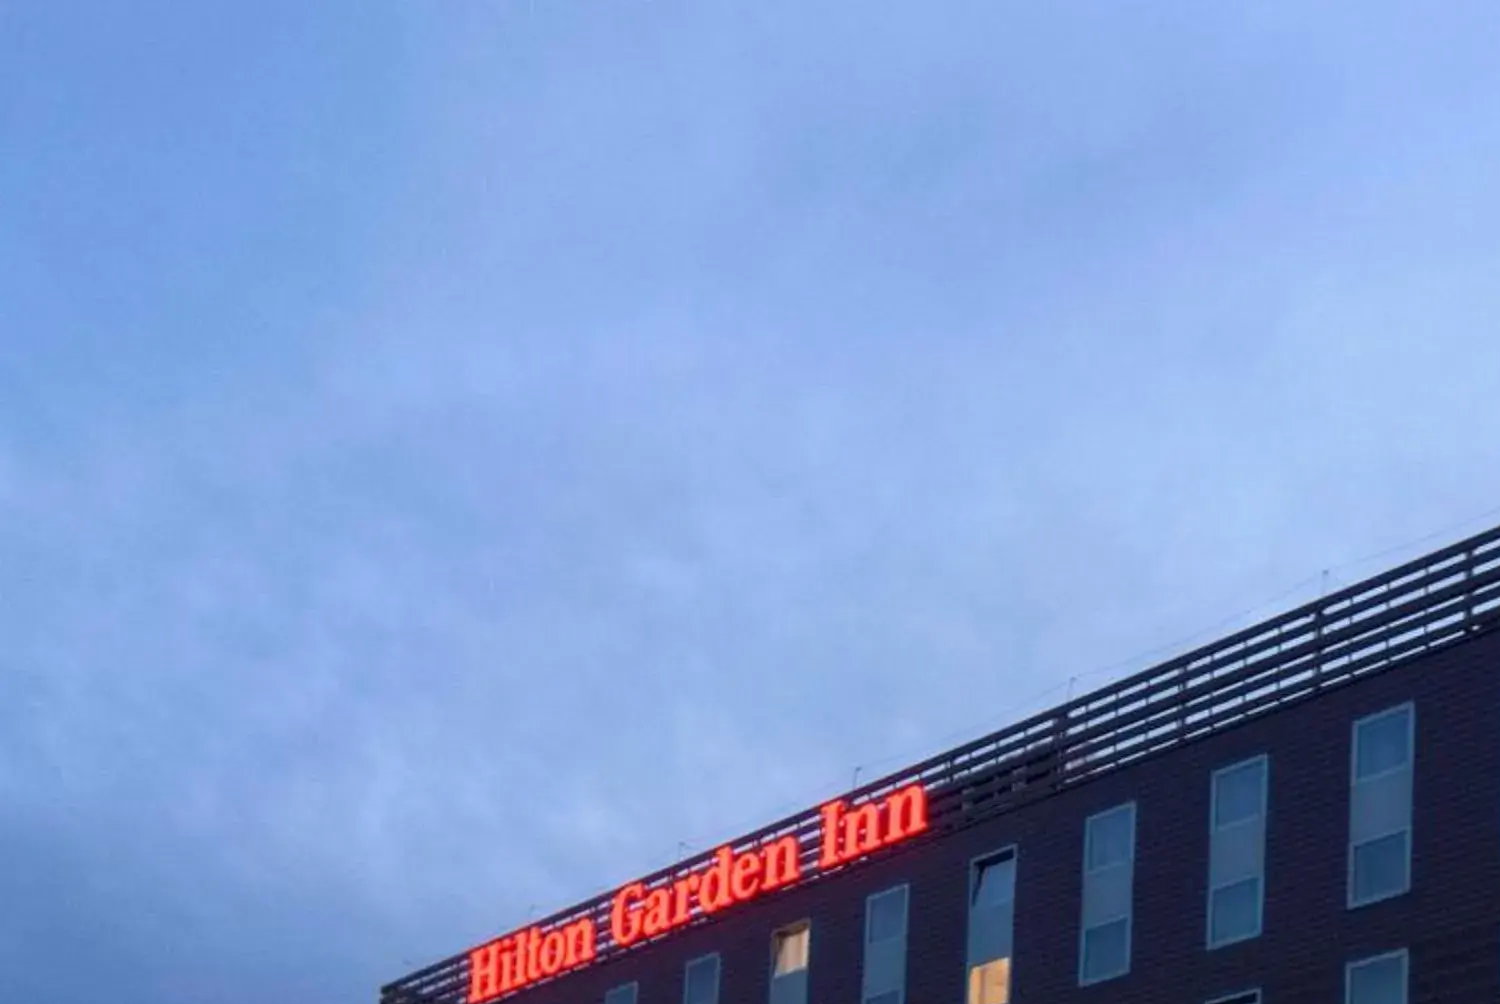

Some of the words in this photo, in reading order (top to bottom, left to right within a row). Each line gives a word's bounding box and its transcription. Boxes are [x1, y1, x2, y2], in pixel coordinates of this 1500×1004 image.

[468, 918, 594, 1004] Hilton
[610, 835, 799, 946] Garden
[819, 783, 927, 868] Inn
